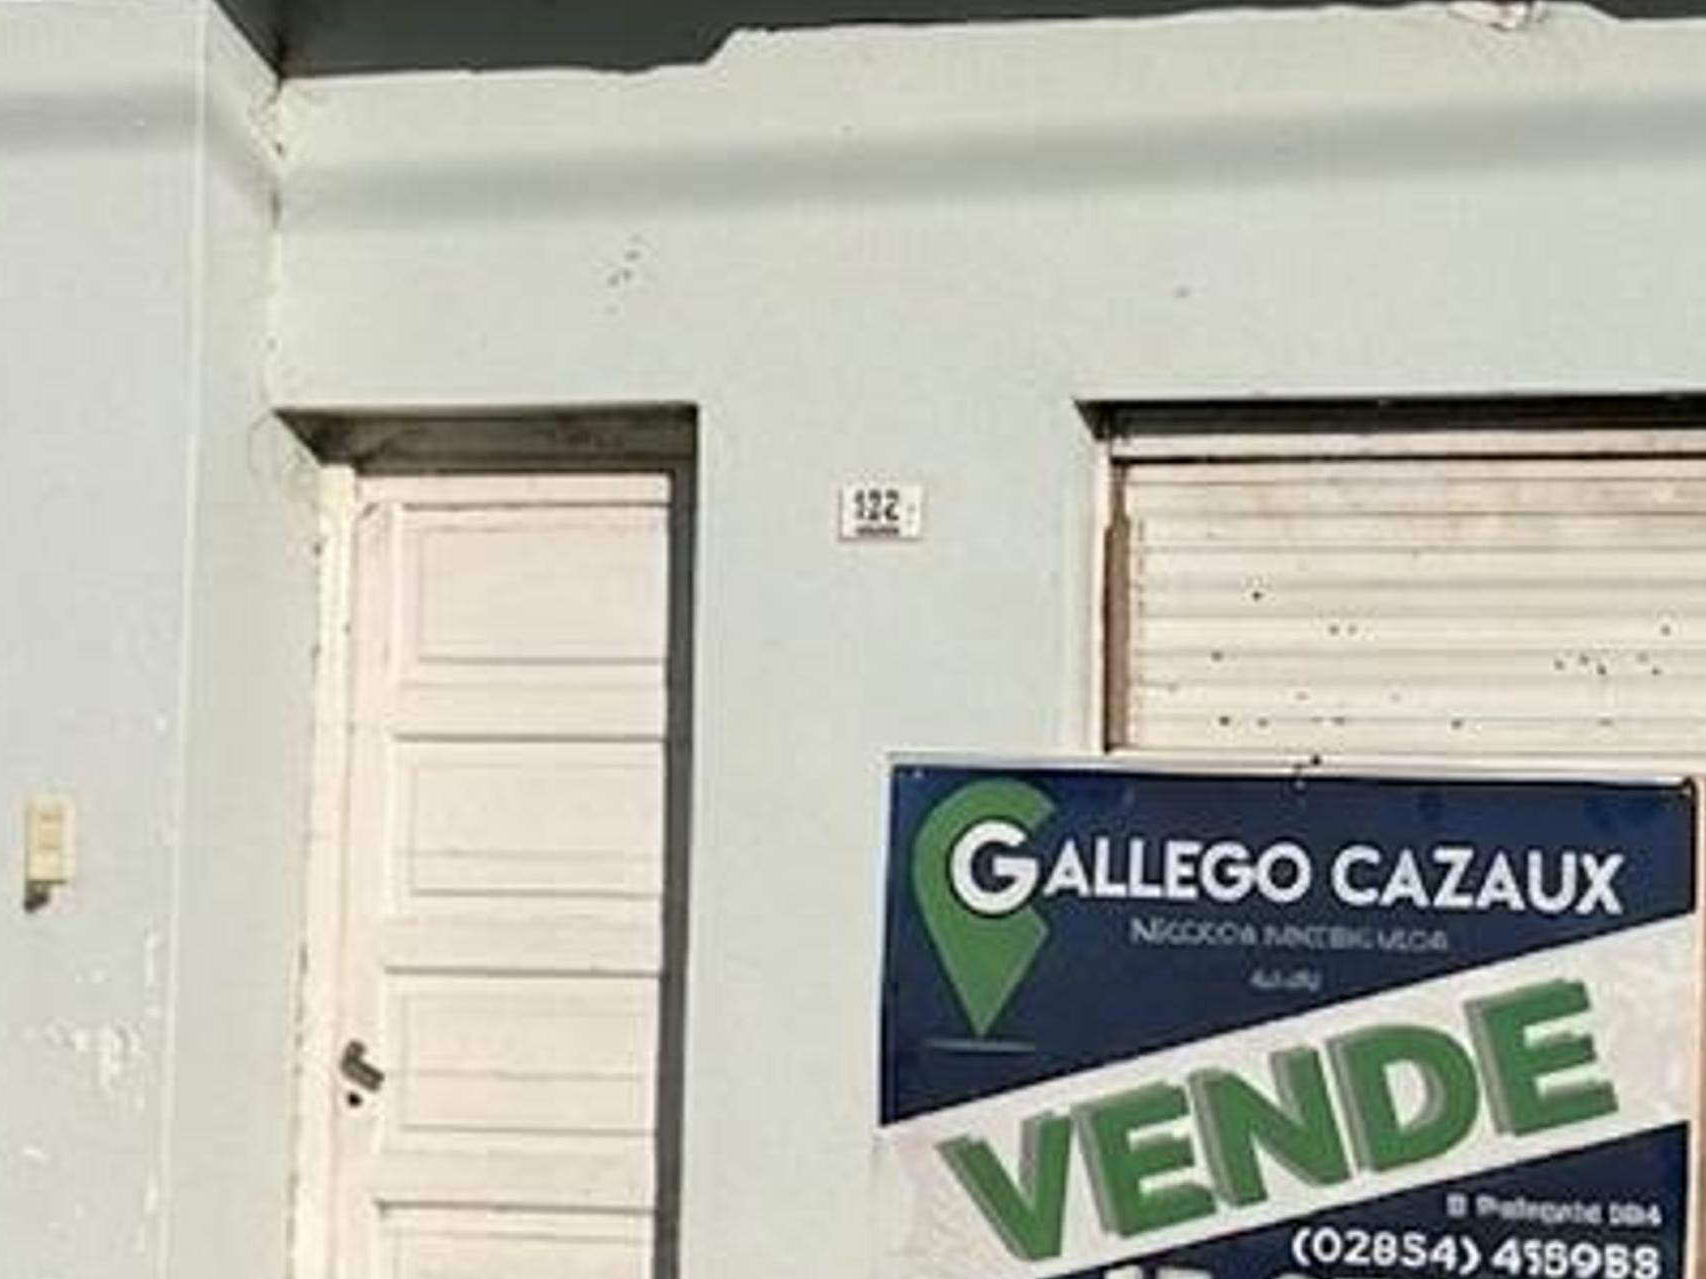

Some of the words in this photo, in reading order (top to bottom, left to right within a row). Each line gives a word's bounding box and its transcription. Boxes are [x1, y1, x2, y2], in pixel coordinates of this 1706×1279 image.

[949, 818, 1312, 917] GALLEGO
[1332, 847, 1626, 916] CAZAUX
[936, 977, 1620, 1262] VENDE
